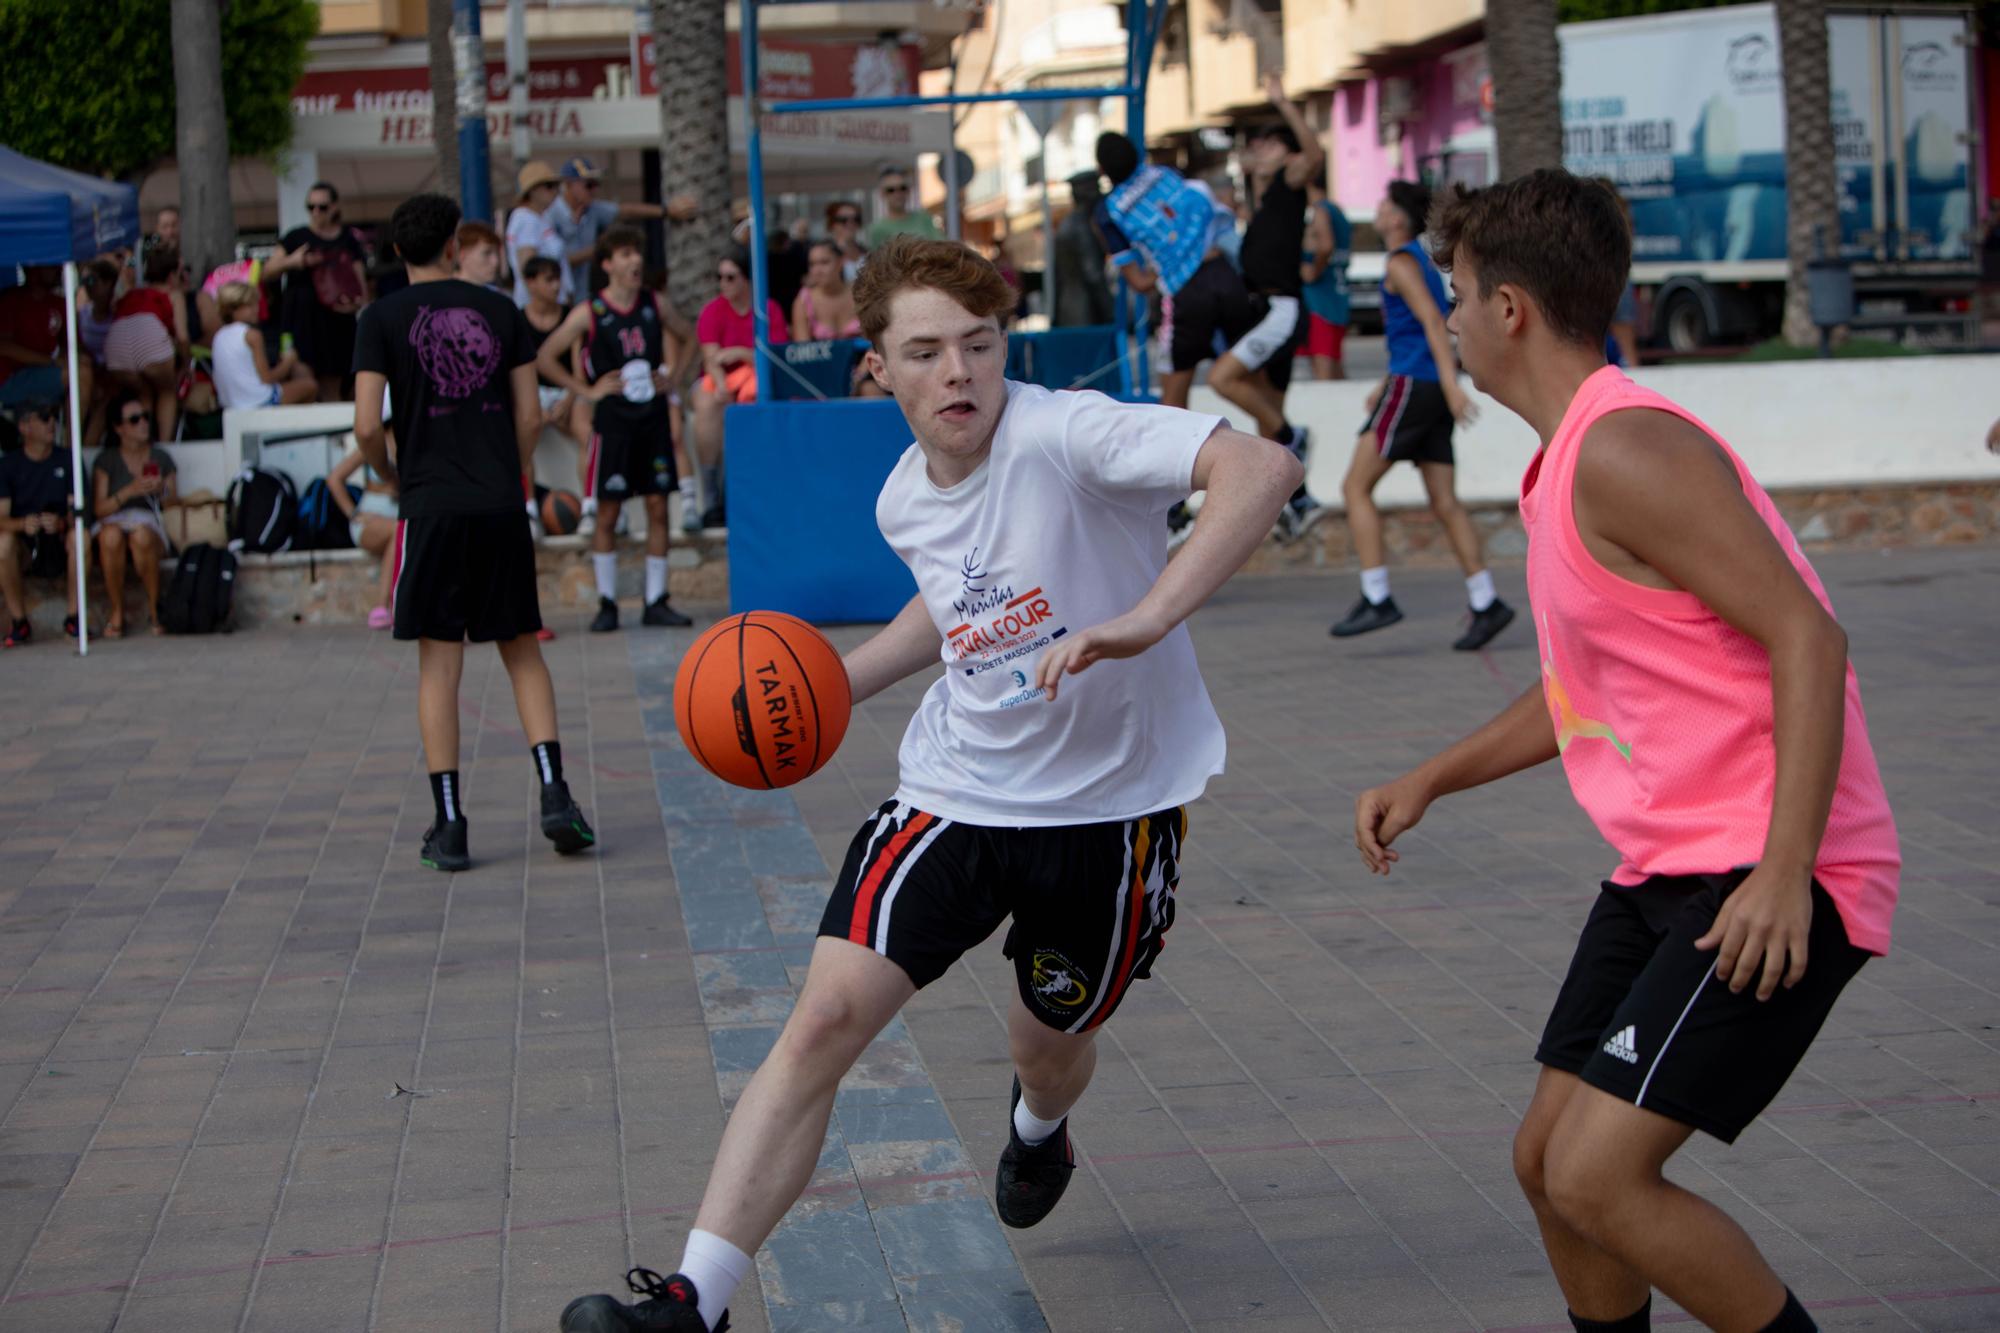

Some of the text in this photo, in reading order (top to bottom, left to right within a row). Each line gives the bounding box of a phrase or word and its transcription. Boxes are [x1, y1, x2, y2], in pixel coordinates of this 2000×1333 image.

[953, 585, 1014, 622] Maristas
[992, 599, 1053, 639] FOUR
[976, 636, 1050, 673] CADETE MASCULINO
[756, 660, 797, 771] TARMAK
[999, 687, 1047, 708] superDum
[1603, 1041, 1638, 1064] adidas
